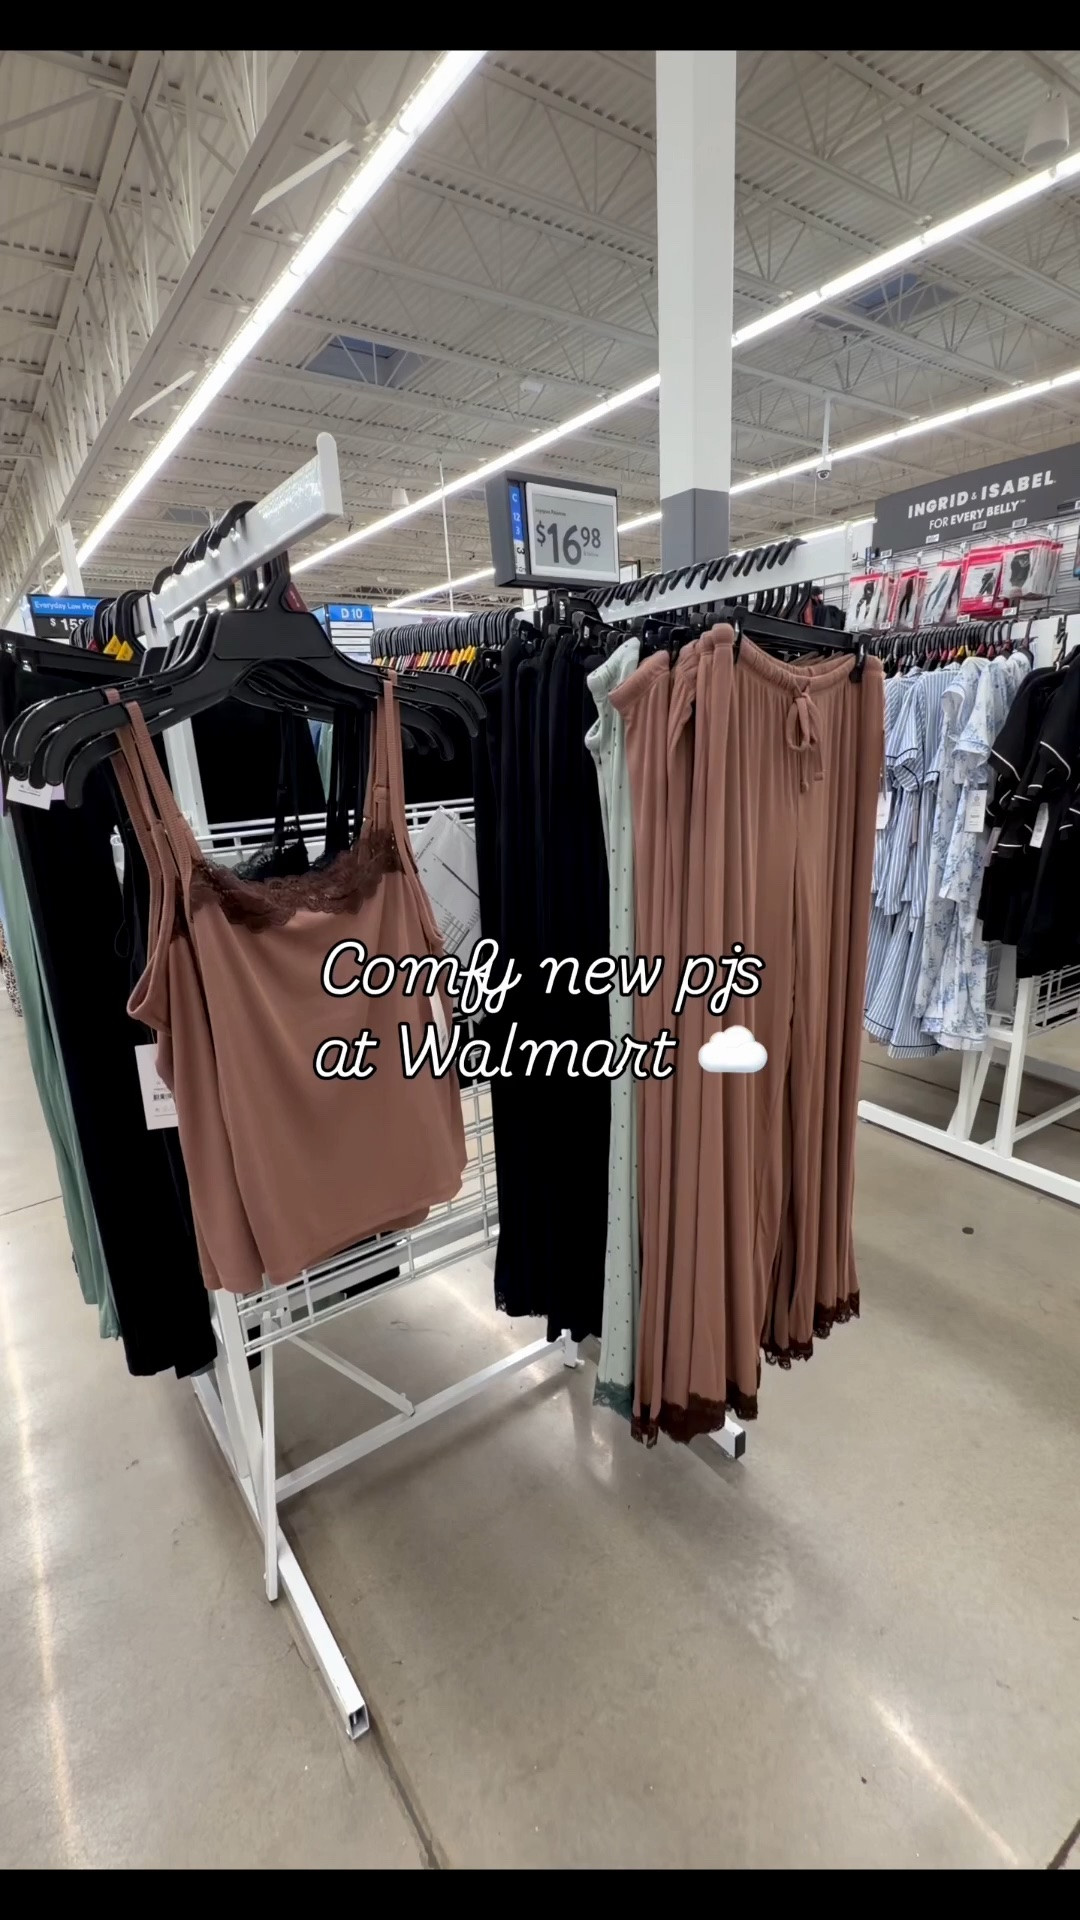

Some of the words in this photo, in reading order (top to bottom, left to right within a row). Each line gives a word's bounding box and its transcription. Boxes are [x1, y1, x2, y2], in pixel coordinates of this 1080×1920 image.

[511, 493, 518, 502] C
[908, 491, 969, 519] INGRID
[971, 492, 977, 501] &
[981, 470, 1055, 501] ISABEL
[512, 512, 521, 521] 12
[929, 517, 949, 530] FOR
[950, 508, 985, 526] EVERY
[34, 600, 66, 610] Everyday
[341, 608, 350, 619] D
[352, 608, 363, 619] 10
